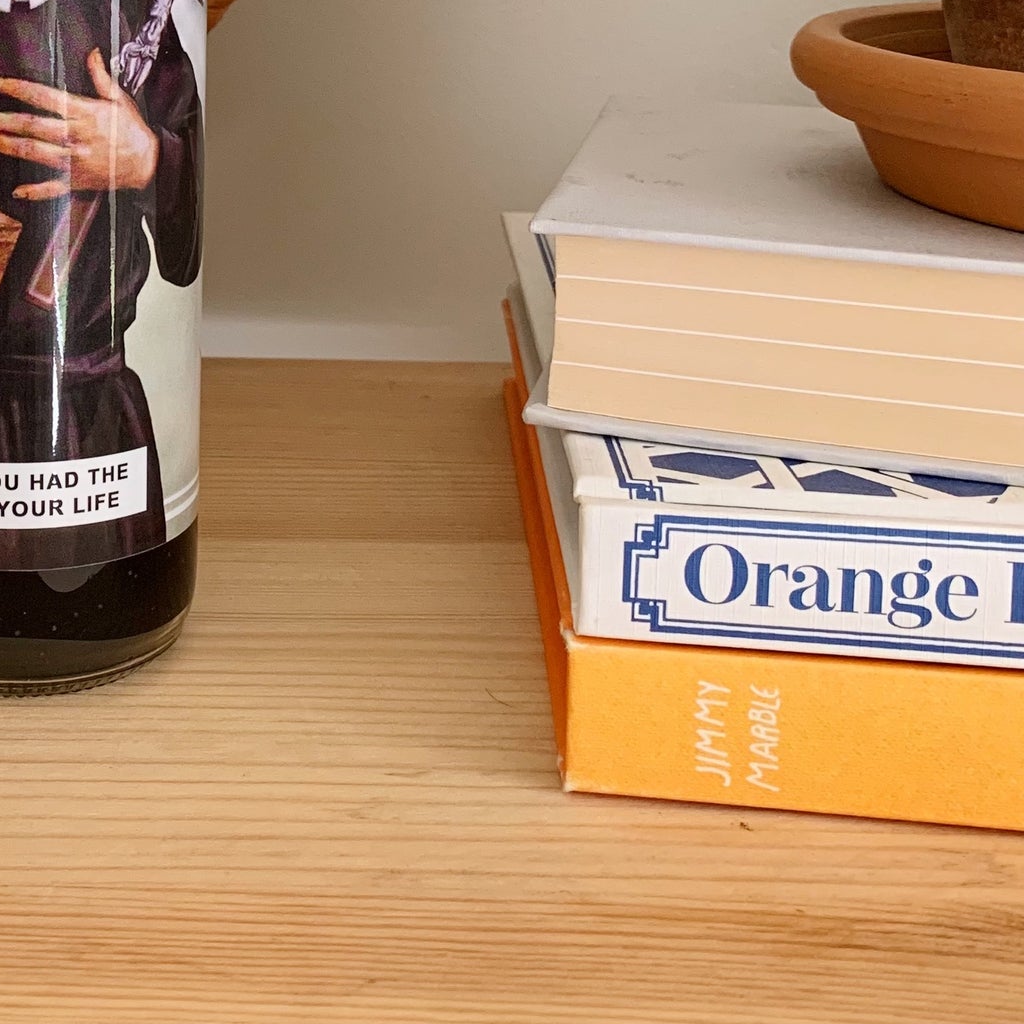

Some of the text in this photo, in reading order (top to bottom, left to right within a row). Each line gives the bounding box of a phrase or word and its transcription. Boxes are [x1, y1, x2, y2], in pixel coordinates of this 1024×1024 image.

[29, 471, 79, 490] HAD
[88, 462, 129, 485] THE
[73, 490, 120, 514] LIFE
[684, 542, 979, 629] Orange
[694, 679, 732, 788] JIMMY
[745, 682, 782, 793] MARBLE
